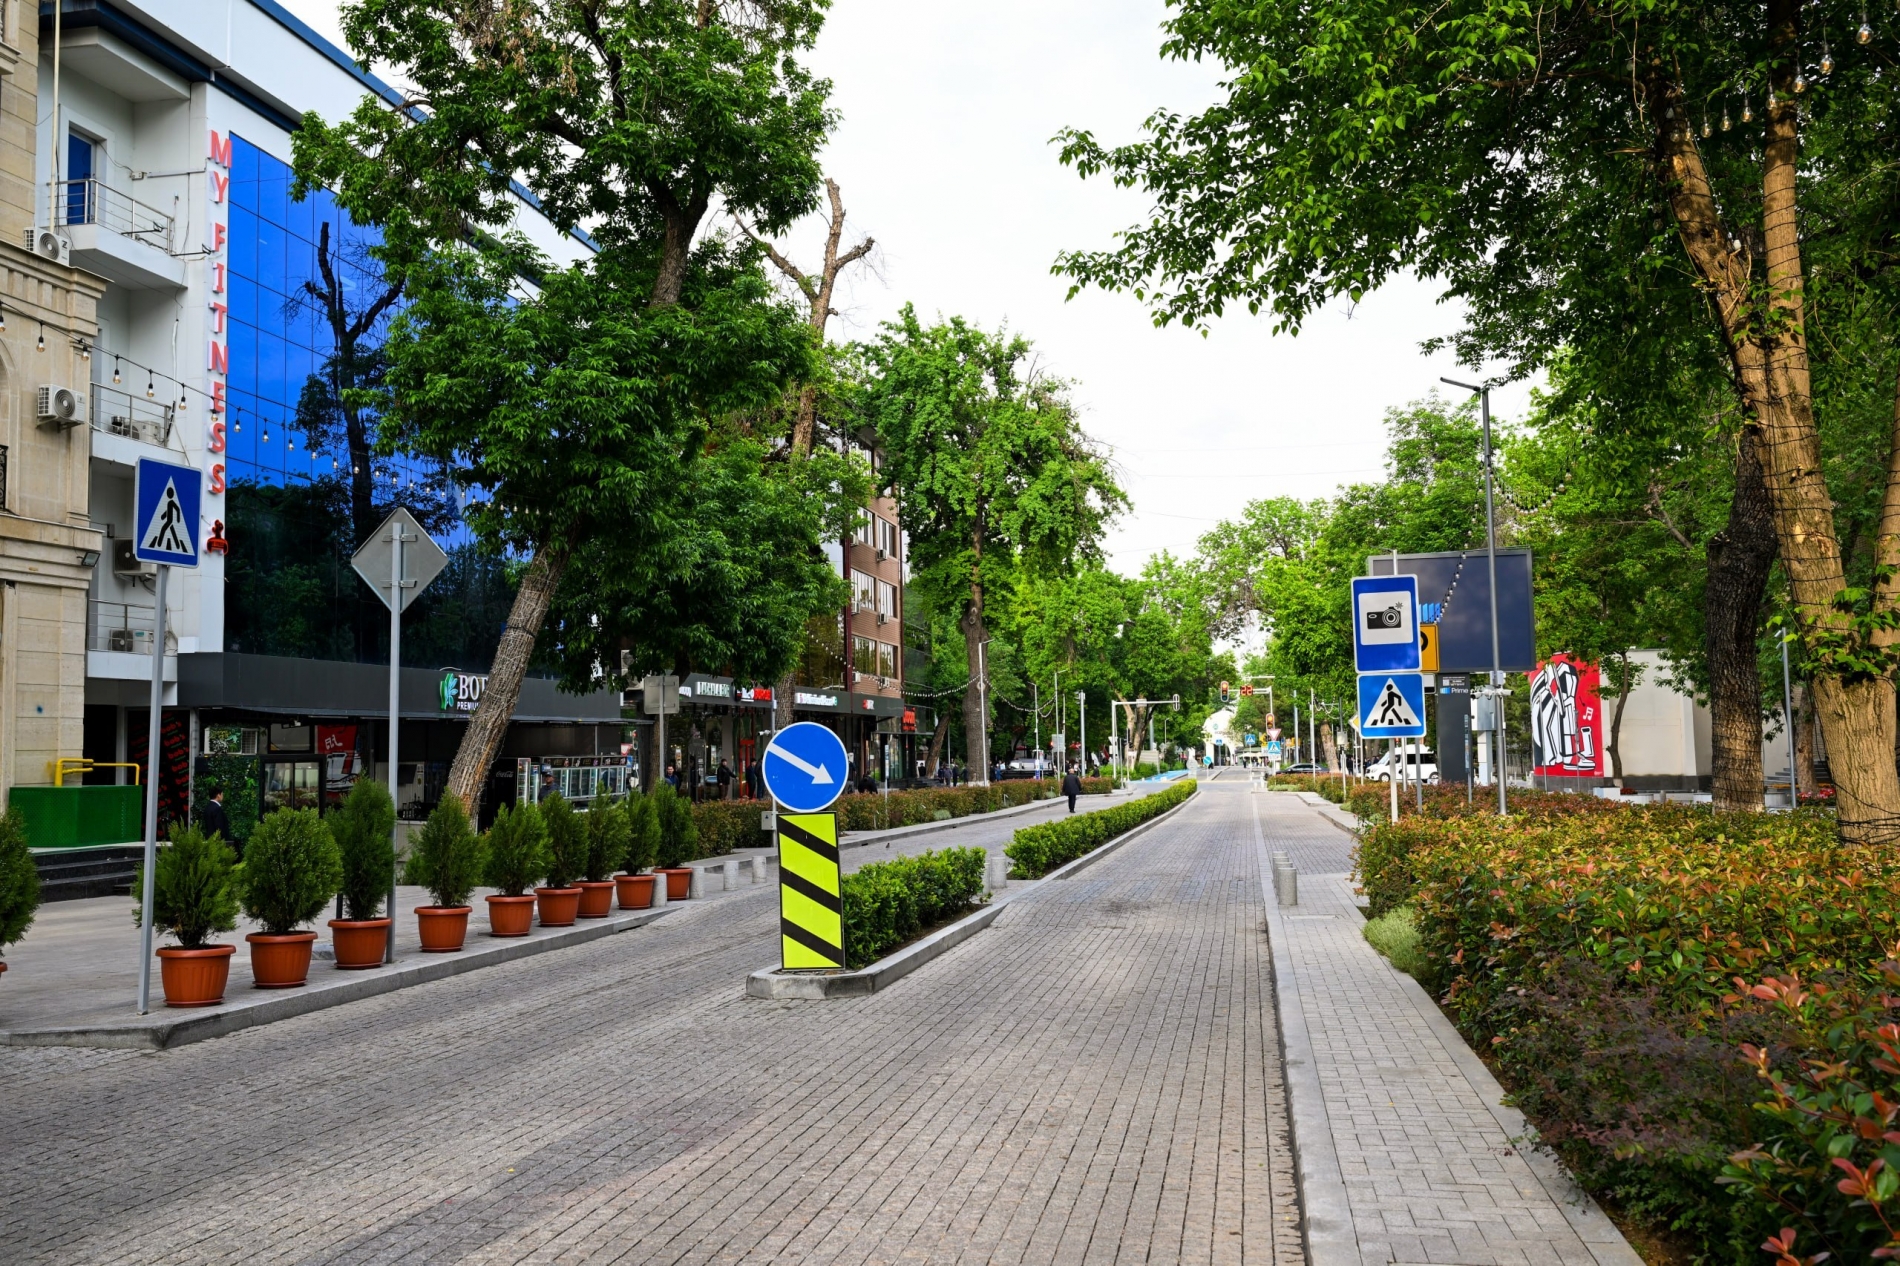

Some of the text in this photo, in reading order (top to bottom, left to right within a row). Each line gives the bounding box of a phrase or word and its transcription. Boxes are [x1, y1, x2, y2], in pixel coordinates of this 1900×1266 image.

[208, 131, 232, 494] MY FITNESS
[457, 674, 489, 701] BOT
[1240, 685, 1253, 696] 22
